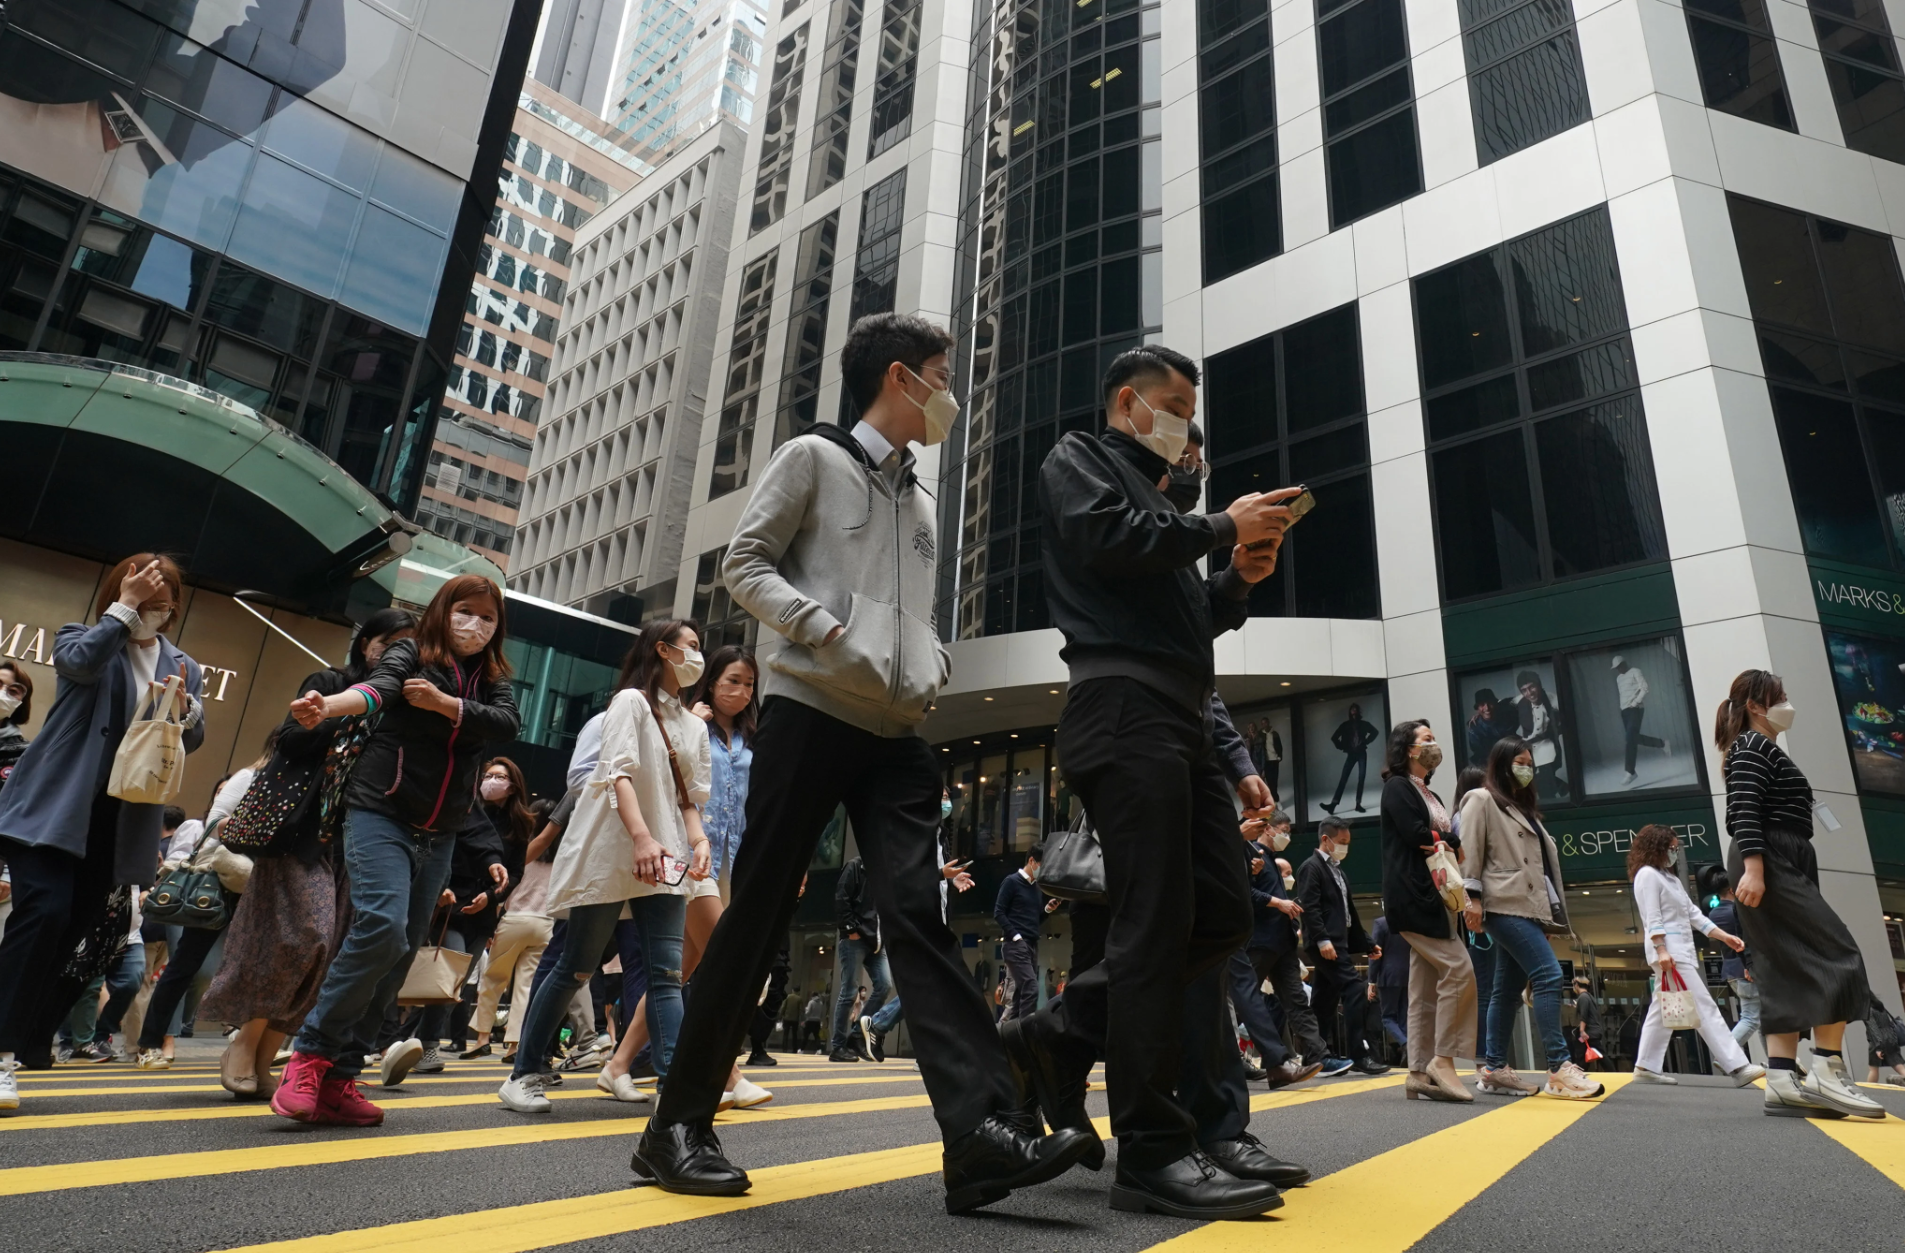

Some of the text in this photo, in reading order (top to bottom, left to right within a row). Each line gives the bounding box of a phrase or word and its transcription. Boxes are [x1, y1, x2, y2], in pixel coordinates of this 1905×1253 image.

[1817, 580, 1892, 613] MARKS
[1562, 823, 1709, 857] & SPEER
